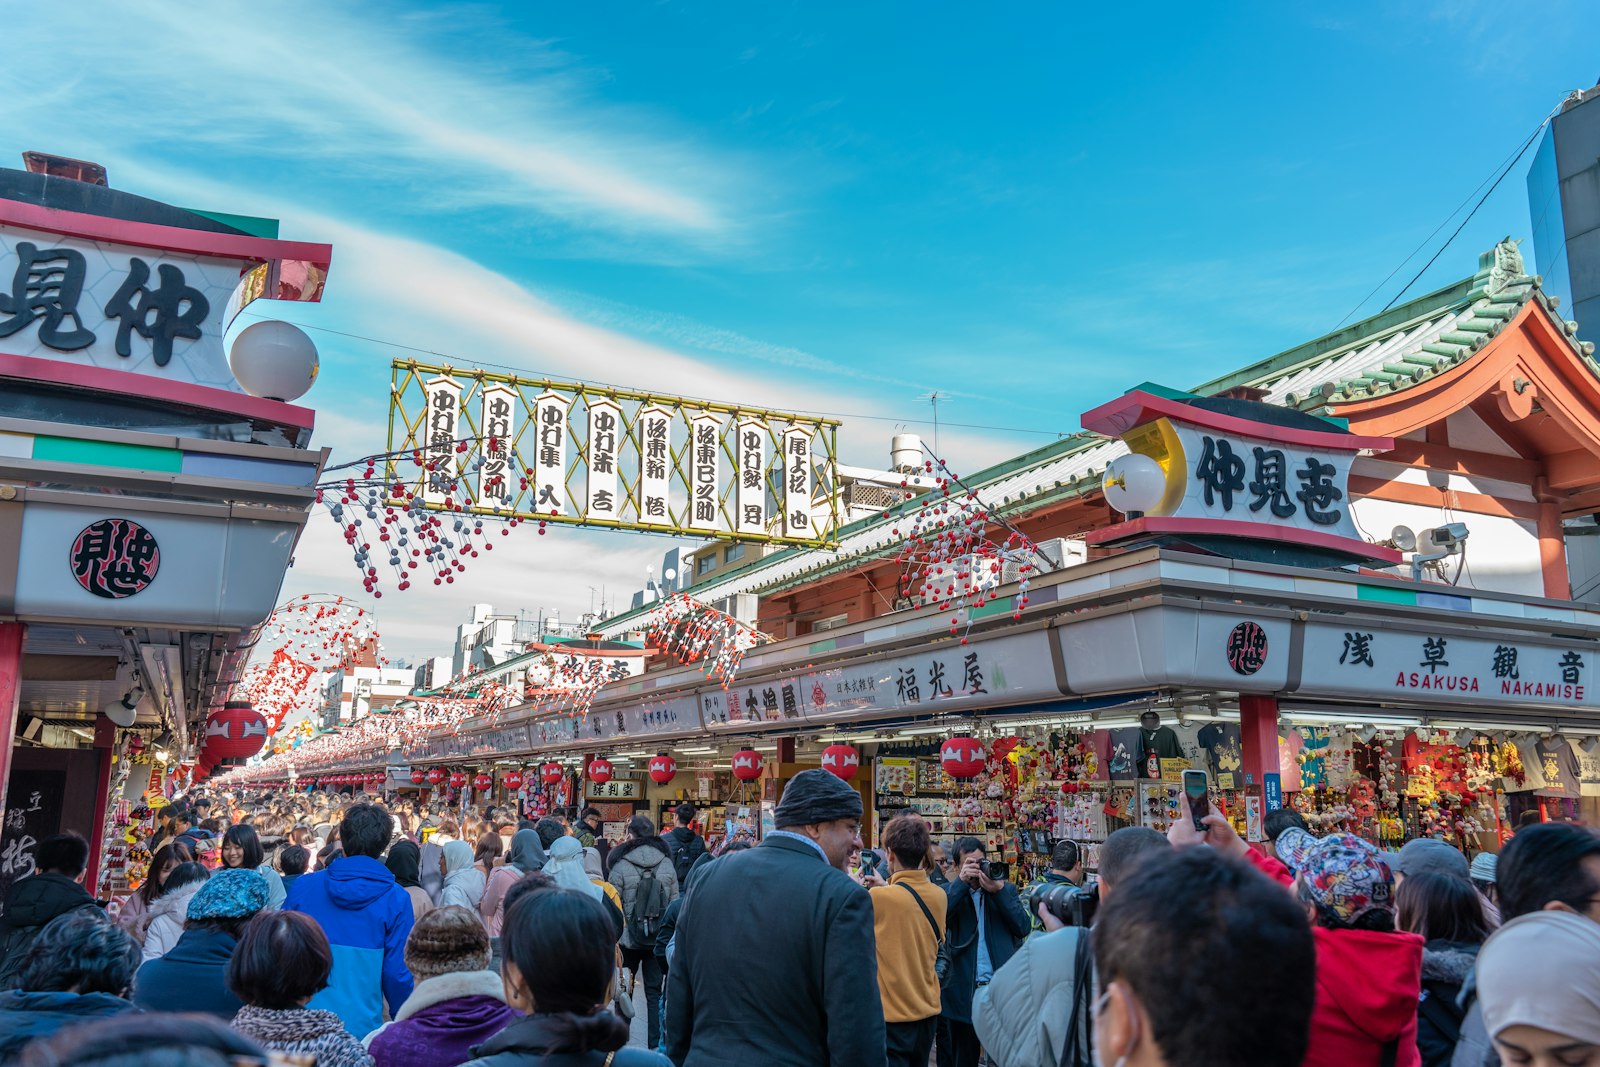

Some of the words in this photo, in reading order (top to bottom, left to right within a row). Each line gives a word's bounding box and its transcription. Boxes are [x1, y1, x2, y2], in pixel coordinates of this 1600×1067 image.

[1196, 435, 1343, 526] 仲見世
[896, 651, 989, 705] 福光屋
[1339, 631, 1585, 684] 浅草観音
[1396, 672, 1480, 693] ASAKUSA
[1500, 681, 1585, 700] NAKAMISE
